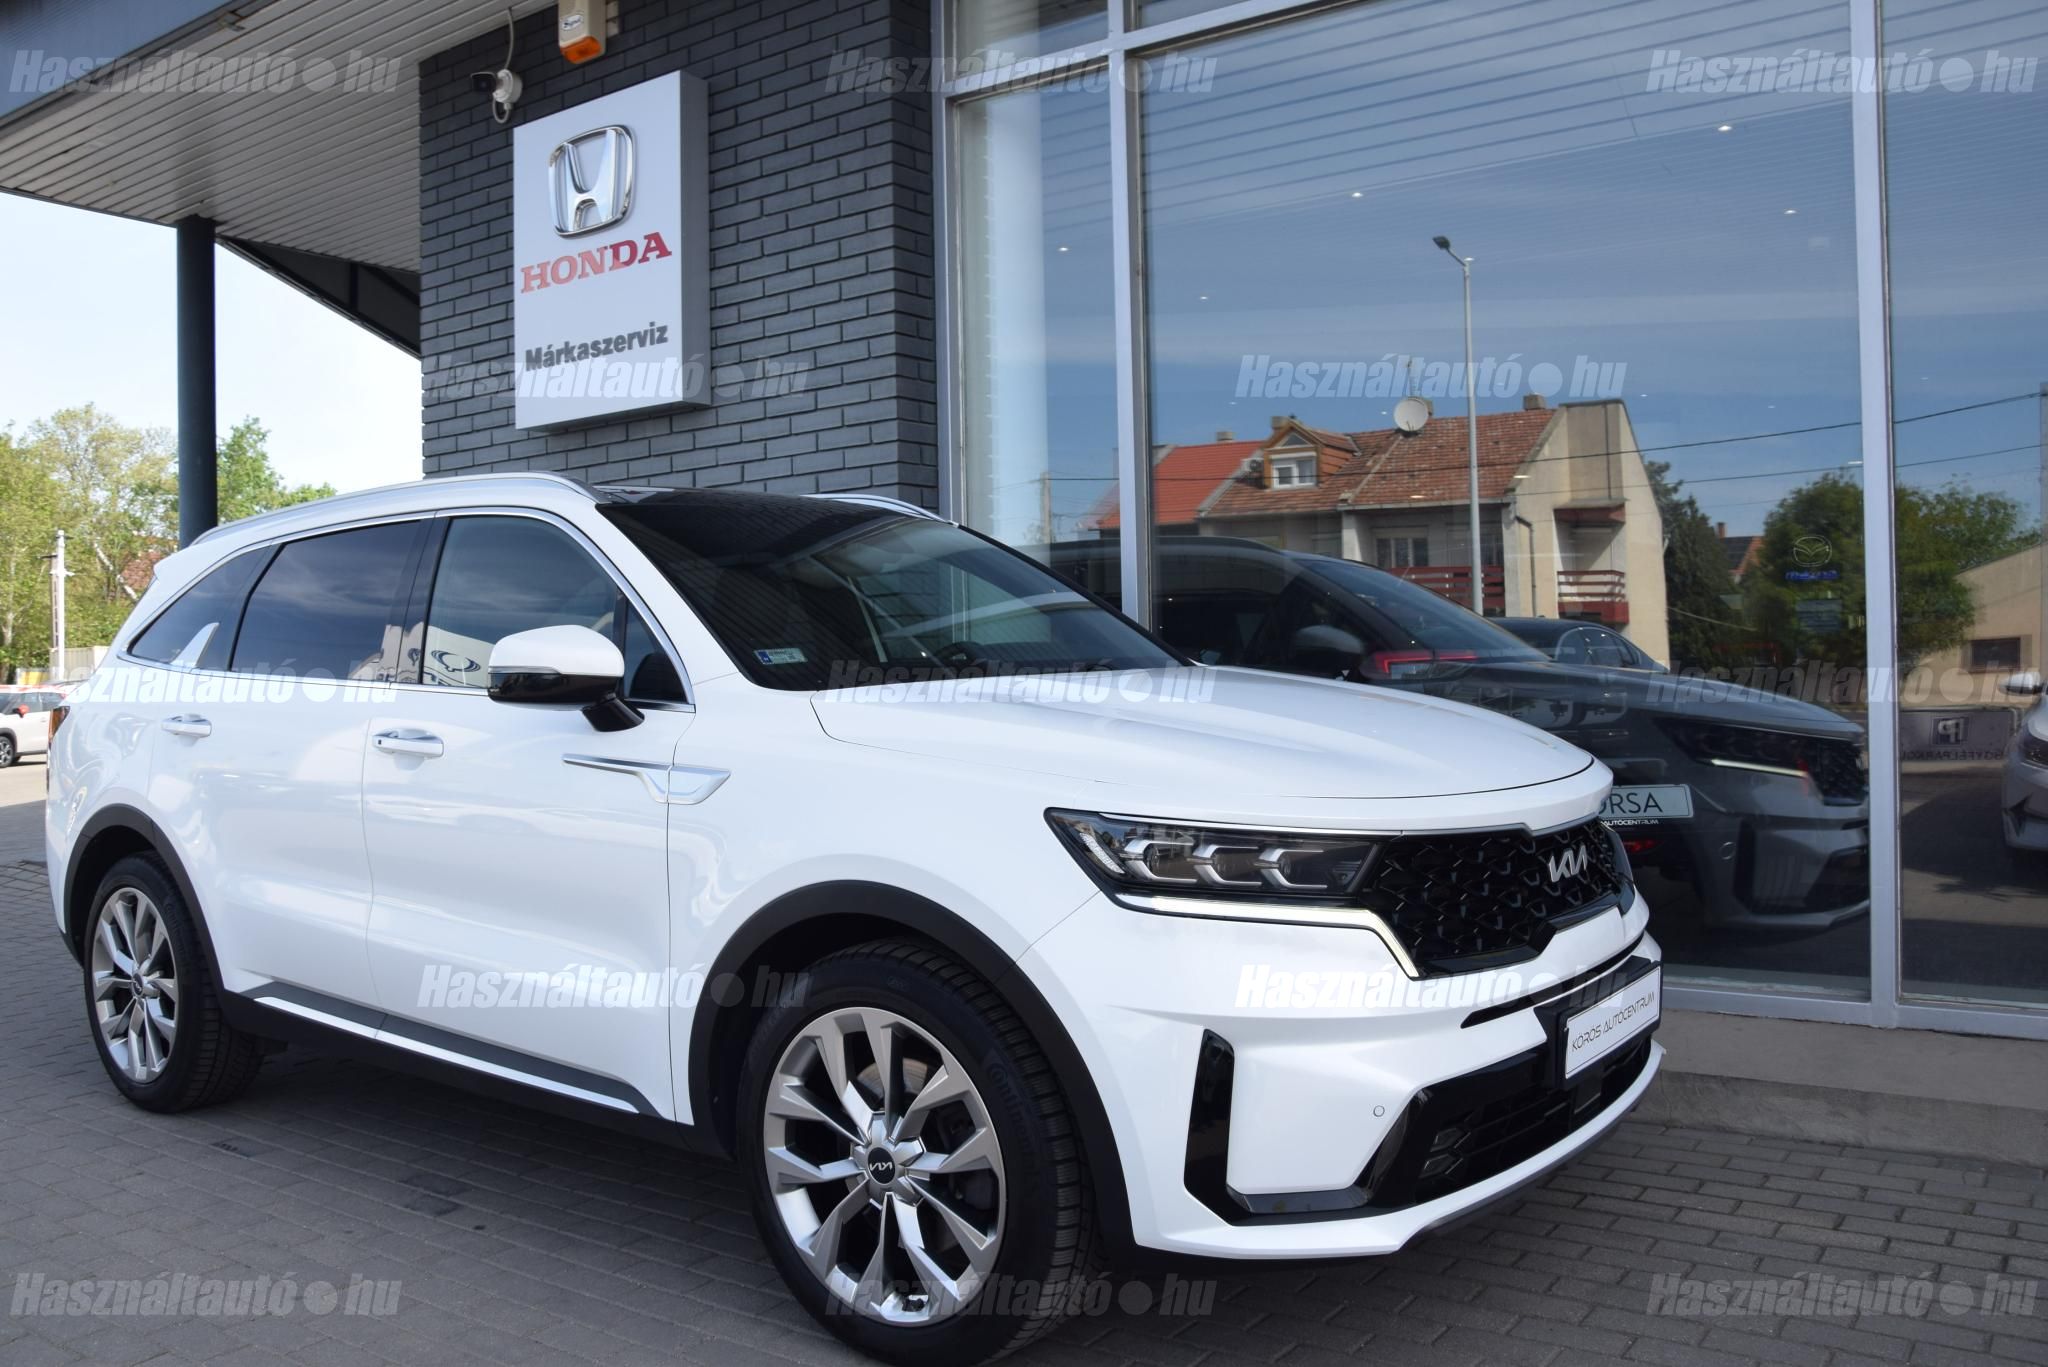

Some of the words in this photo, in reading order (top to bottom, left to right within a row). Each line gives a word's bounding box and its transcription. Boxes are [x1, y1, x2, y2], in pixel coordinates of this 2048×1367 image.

[521, 232, 672, 293] HONDA
[526, 321, 668, 371] Márkaszerviz
[1549, 845, 1588, 883] KIA
